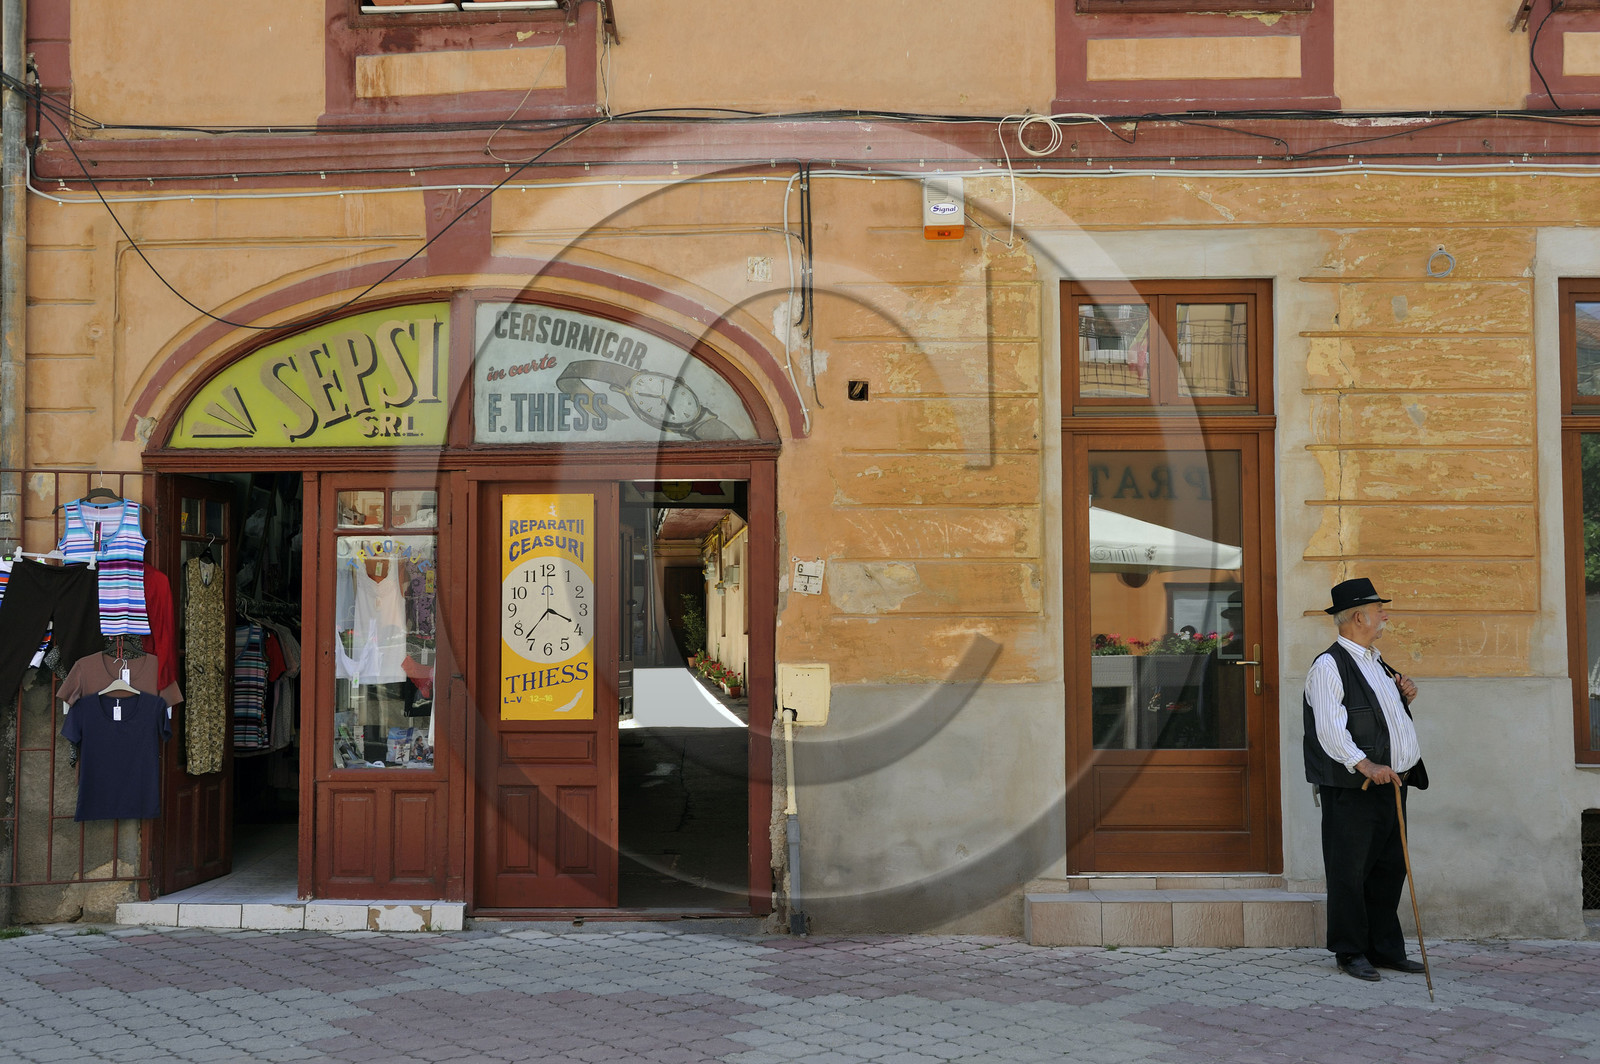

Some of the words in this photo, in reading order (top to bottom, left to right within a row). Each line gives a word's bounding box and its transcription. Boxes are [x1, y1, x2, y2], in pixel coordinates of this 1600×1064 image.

[932, 204, 957, 213] Signal
[494, 310, 648, 370] CEASORNICAR
[486, 366, 507, 382] in
[508, 353, 557, 377] curte
[260, 318, 444, 442] SEPSI
[488, 393, 507, 432] F.
[511, 392, 608, 432] THIESS
[509, 519, 584, 538] REPARATII
[509, 535, 585, 563] CEASURI
[346, 540, 432, 573] TRICOTAJE
[539, 564, 556, 577] 12
[797, 563, 804, 573] G
[523, 570, 537, 583] 11
[564, 570, 571, 583] 1
[511, 586, 528, 600] 10
[575, 585, 585, 599] 2
[507, 602, 518, 618] 9
[579, 603, 588, 617] 3
[513, 621, 524, 636] 8
[573, 623, 584, 636] 4
[525, 638, 536, 651] 7
[543, 642, 553, 656] 6
[559, 637, 570, 651] 5
[505, 661, 589, 694] THIESS
